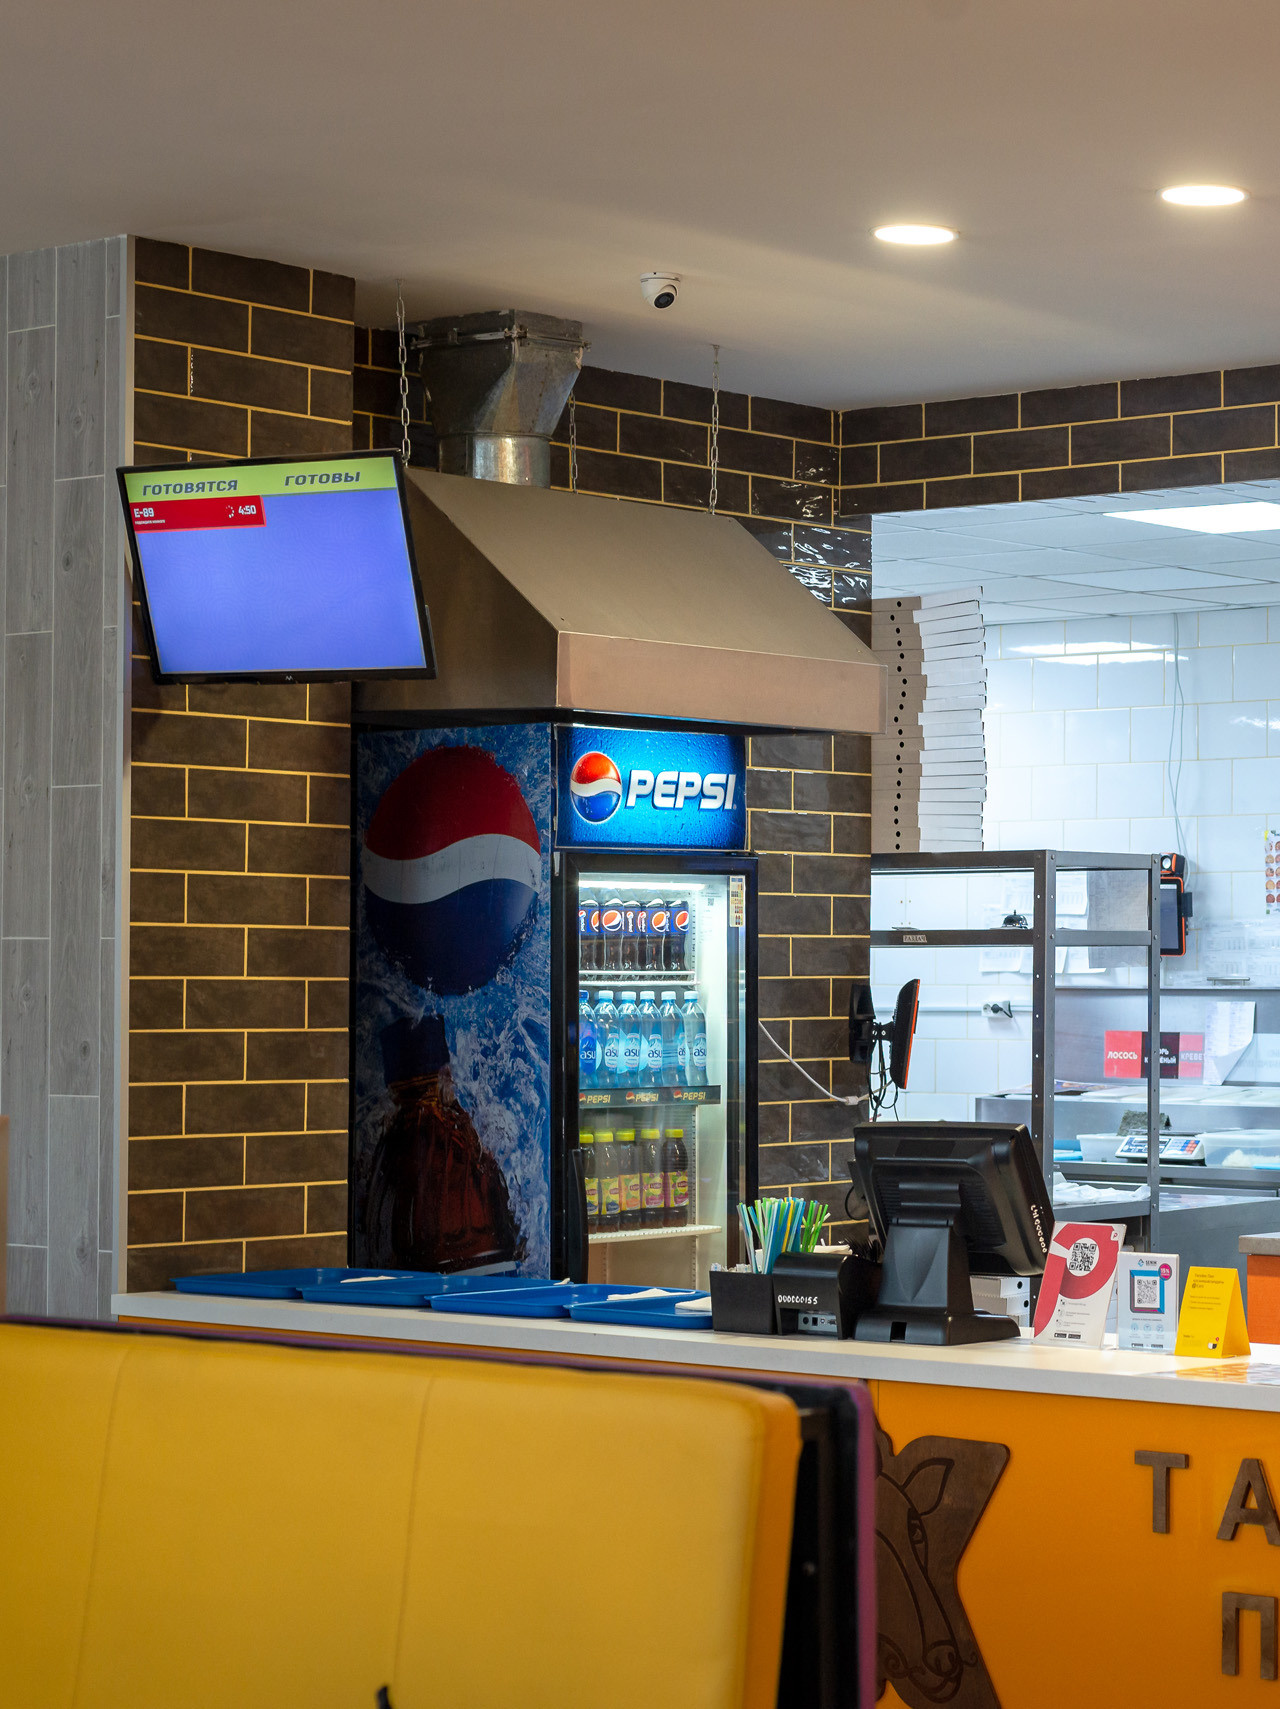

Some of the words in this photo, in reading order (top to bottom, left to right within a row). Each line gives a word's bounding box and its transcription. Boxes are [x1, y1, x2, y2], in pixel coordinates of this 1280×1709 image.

[284, 471, 361, 486] ГОТОВЫ
[142, 479, 238, 496] ГОТОВЯТСЯ
[238, 505, 257, 515] 4:50
[625, 769, 737, 811] PEPSI
[1107, 1051, 1138, 1060] ЛОСОСЬ
[587, 1094, 610, 1103] PEPSI
[636, 1093, 659, 1102] PEPSI
[682, 1092, 706, 1101] PEPSI
